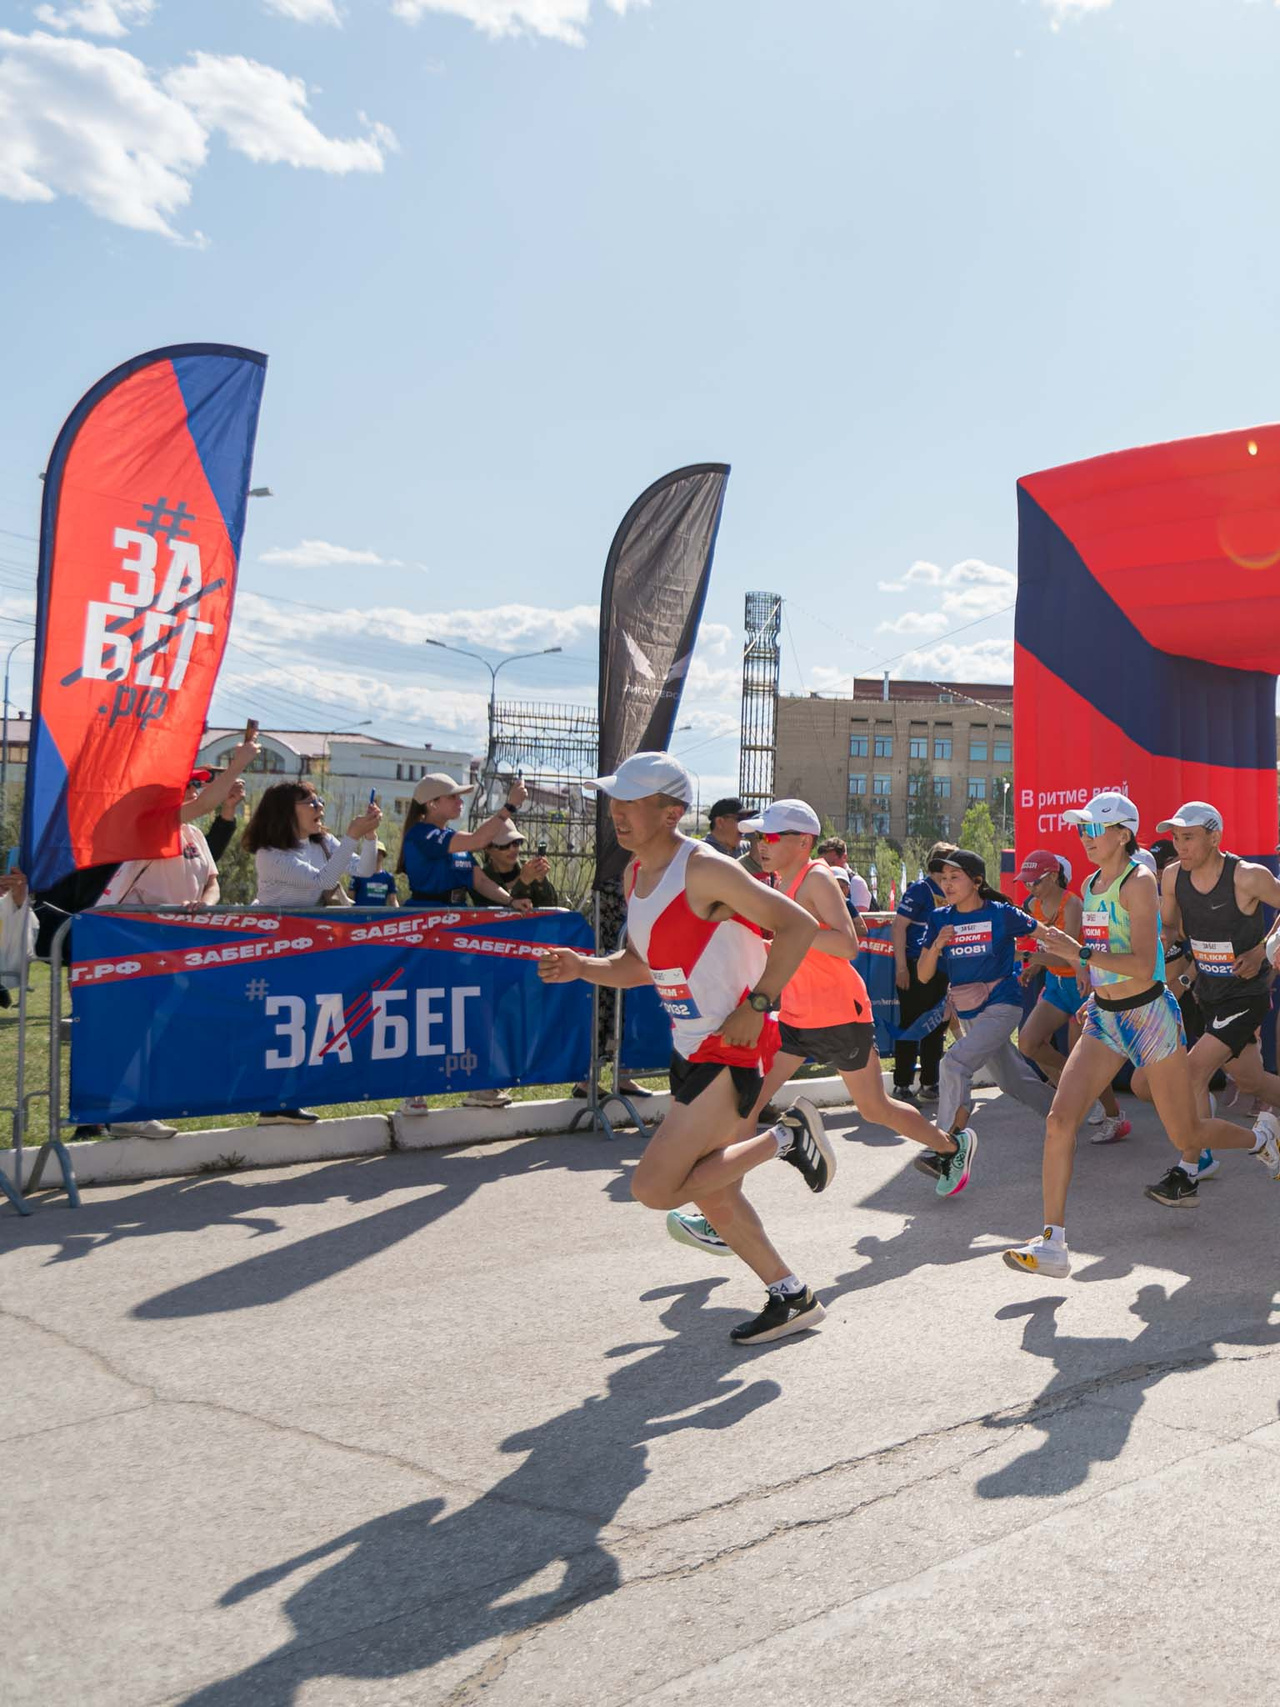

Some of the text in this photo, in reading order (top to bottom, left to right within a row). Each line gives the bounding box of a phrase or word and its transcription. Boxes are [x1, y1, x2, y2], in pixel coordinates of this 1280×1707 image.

[1021, 789, 1034, 808] В
[1038, 788, 1088, 810] ритме
[351, 912, 460, 942] ЗАБЕГ.РФ
[185, 936, 313, 966] ЗАБЕГ.РФ
[950, 944, 986, 956] 10081
